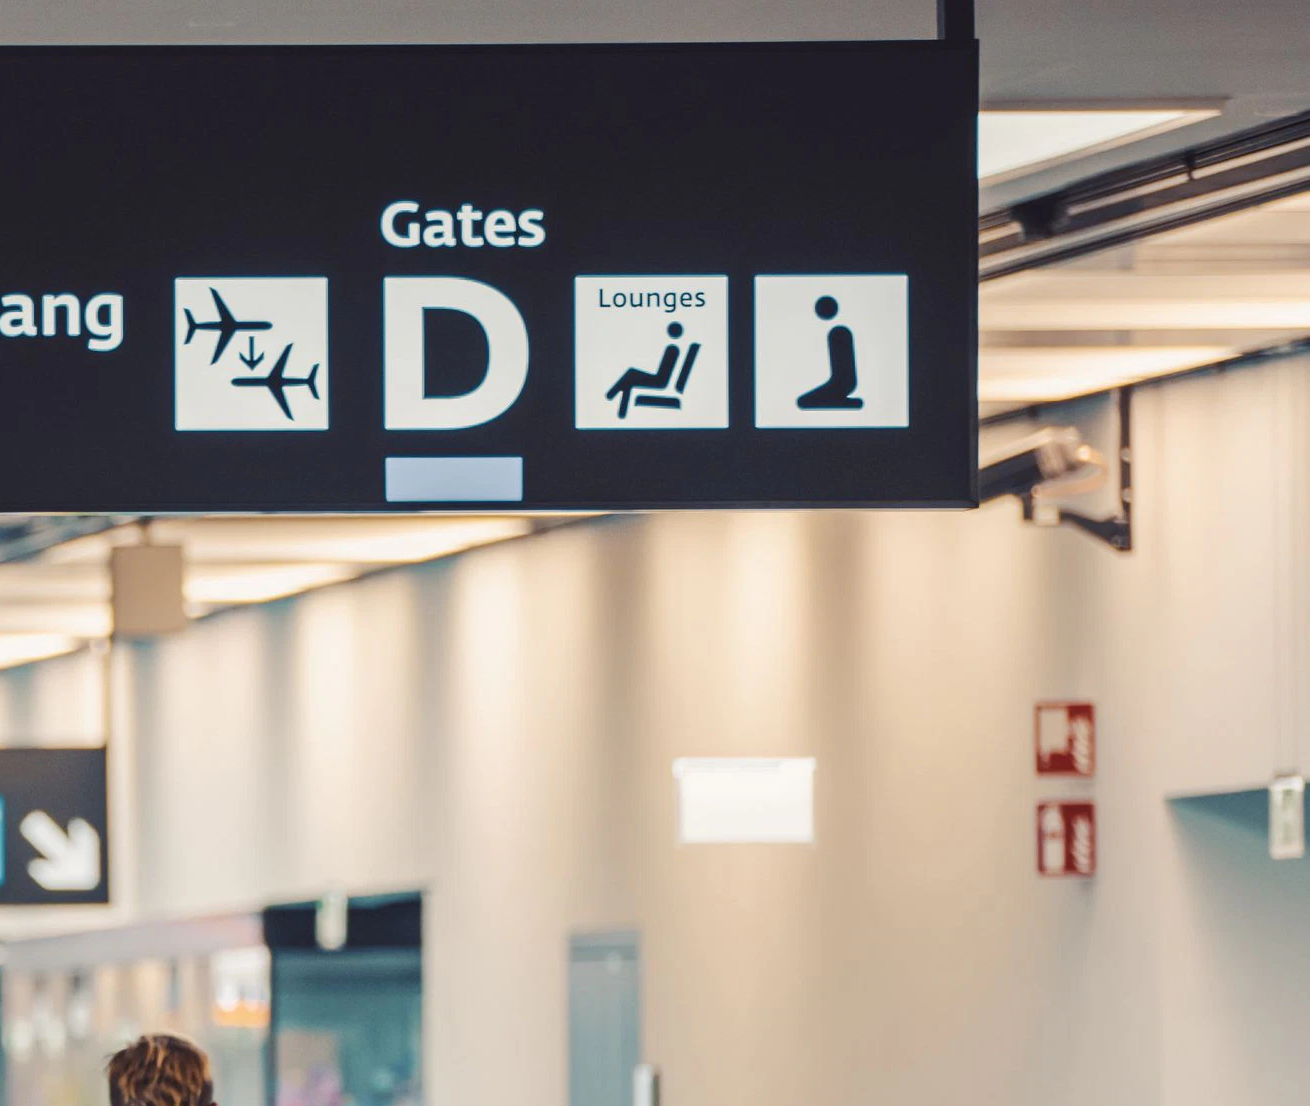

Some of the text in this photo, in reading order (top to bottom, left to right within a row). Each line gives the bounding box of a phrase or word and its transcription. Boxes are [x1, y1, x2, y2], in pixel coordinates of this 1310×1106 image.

[380, 200, 546, 248] Gates
[598, 287, 707, 313] Lounges
[383, 276, 530, 431] D
